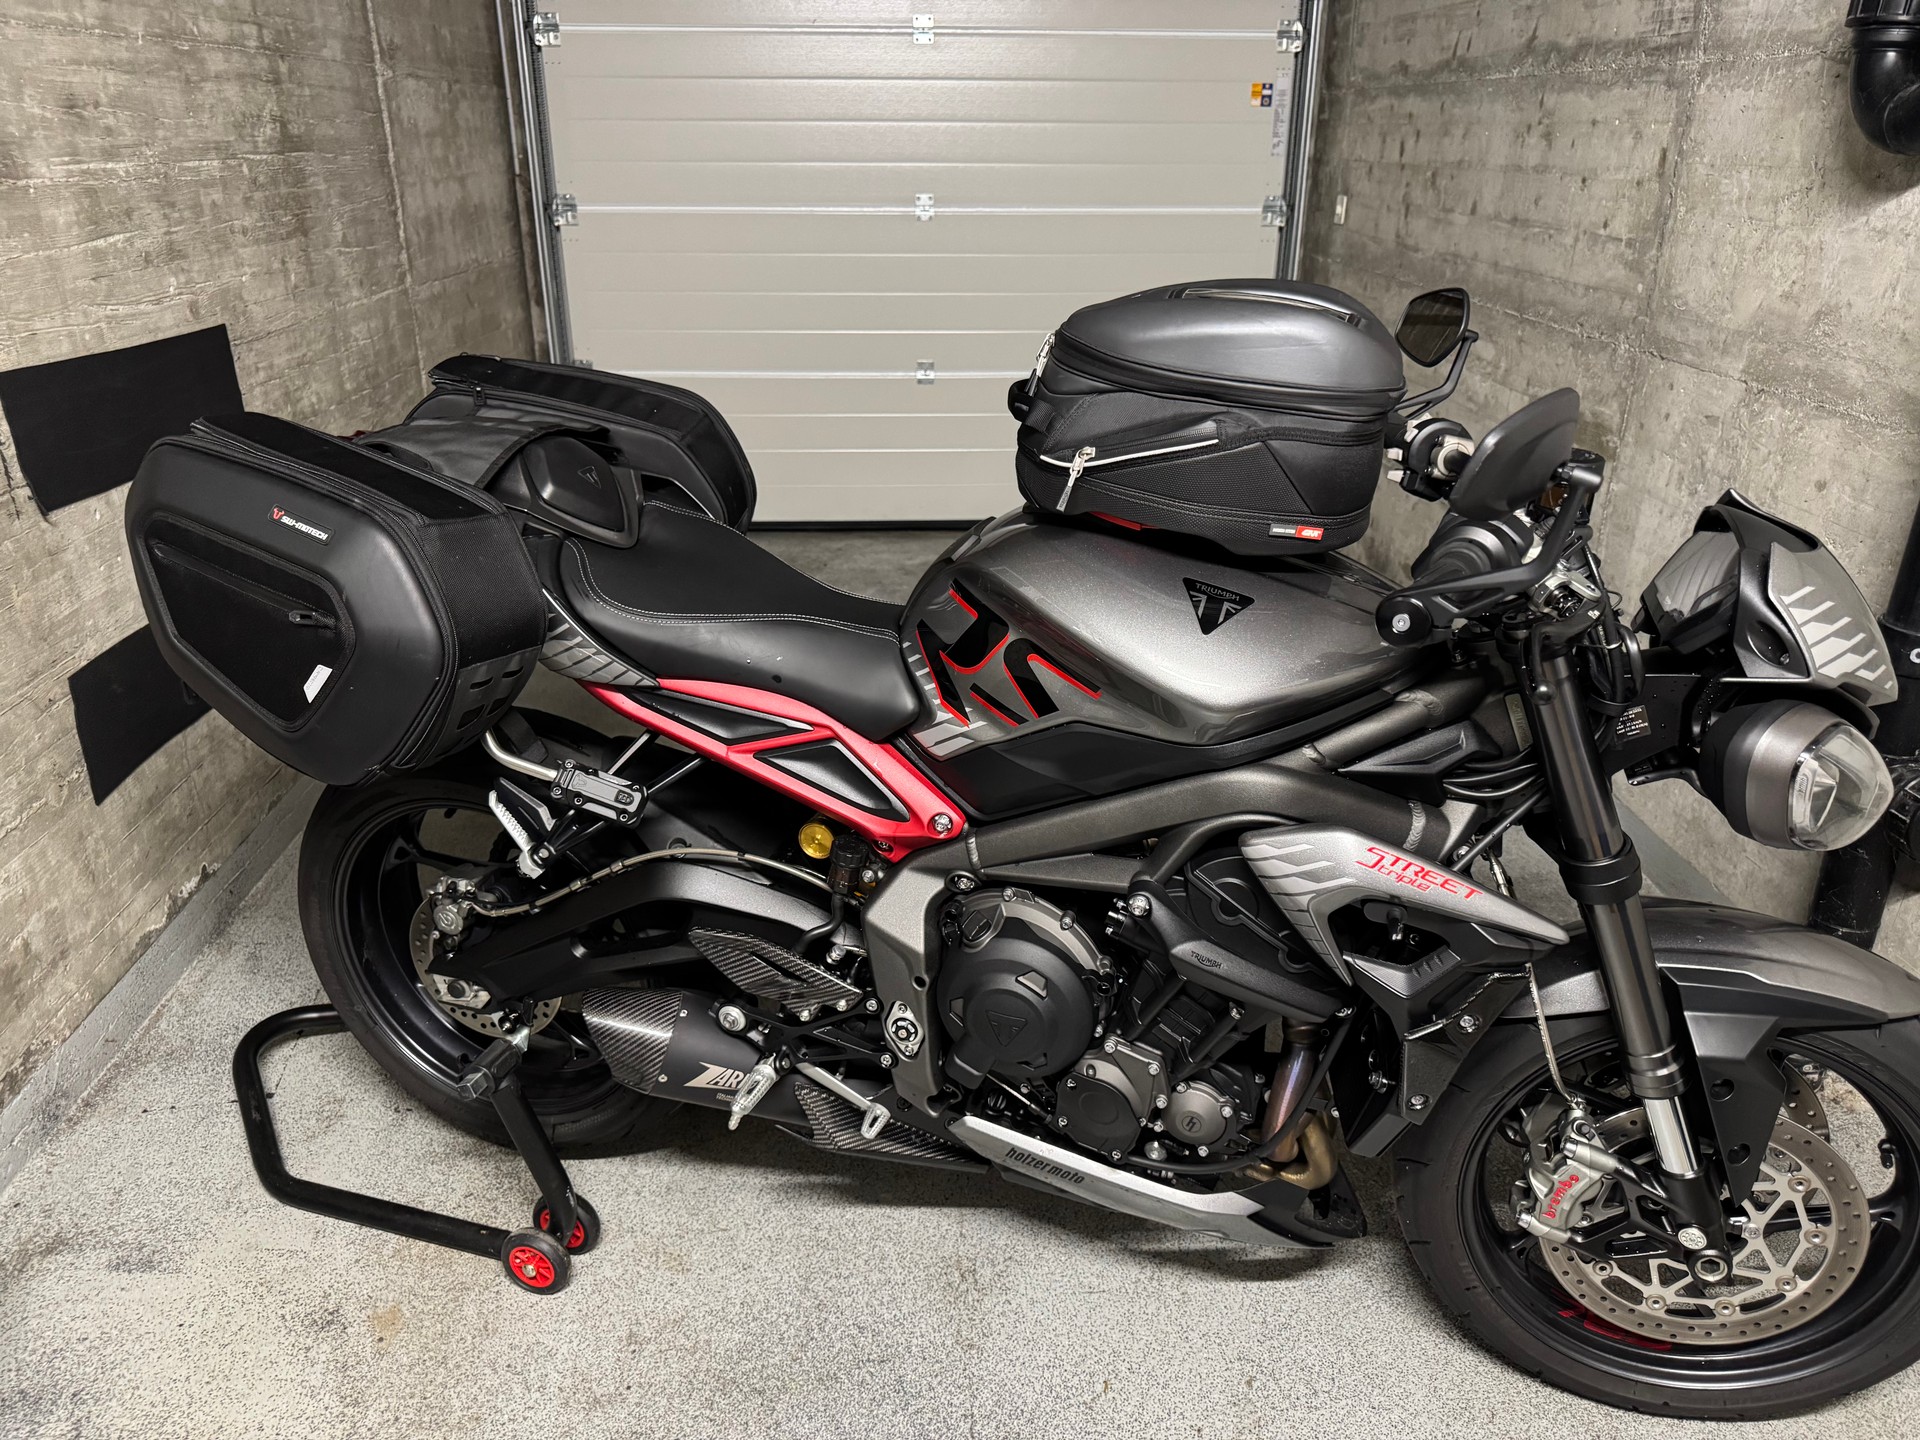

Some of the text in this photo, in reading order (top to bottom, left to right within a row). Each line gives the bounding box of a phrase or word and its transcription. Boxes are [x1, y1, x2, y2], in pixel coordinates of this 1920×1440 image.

[1195, 582, 1240, 601] TRIUMPH
[1355, 846, 1484, 900] STREET
[1377, 864, 1432, 893] triple
[1190, 950, 1223, 969] TRIUMPH
[1541, 1174, 1580, 1219] brembo
